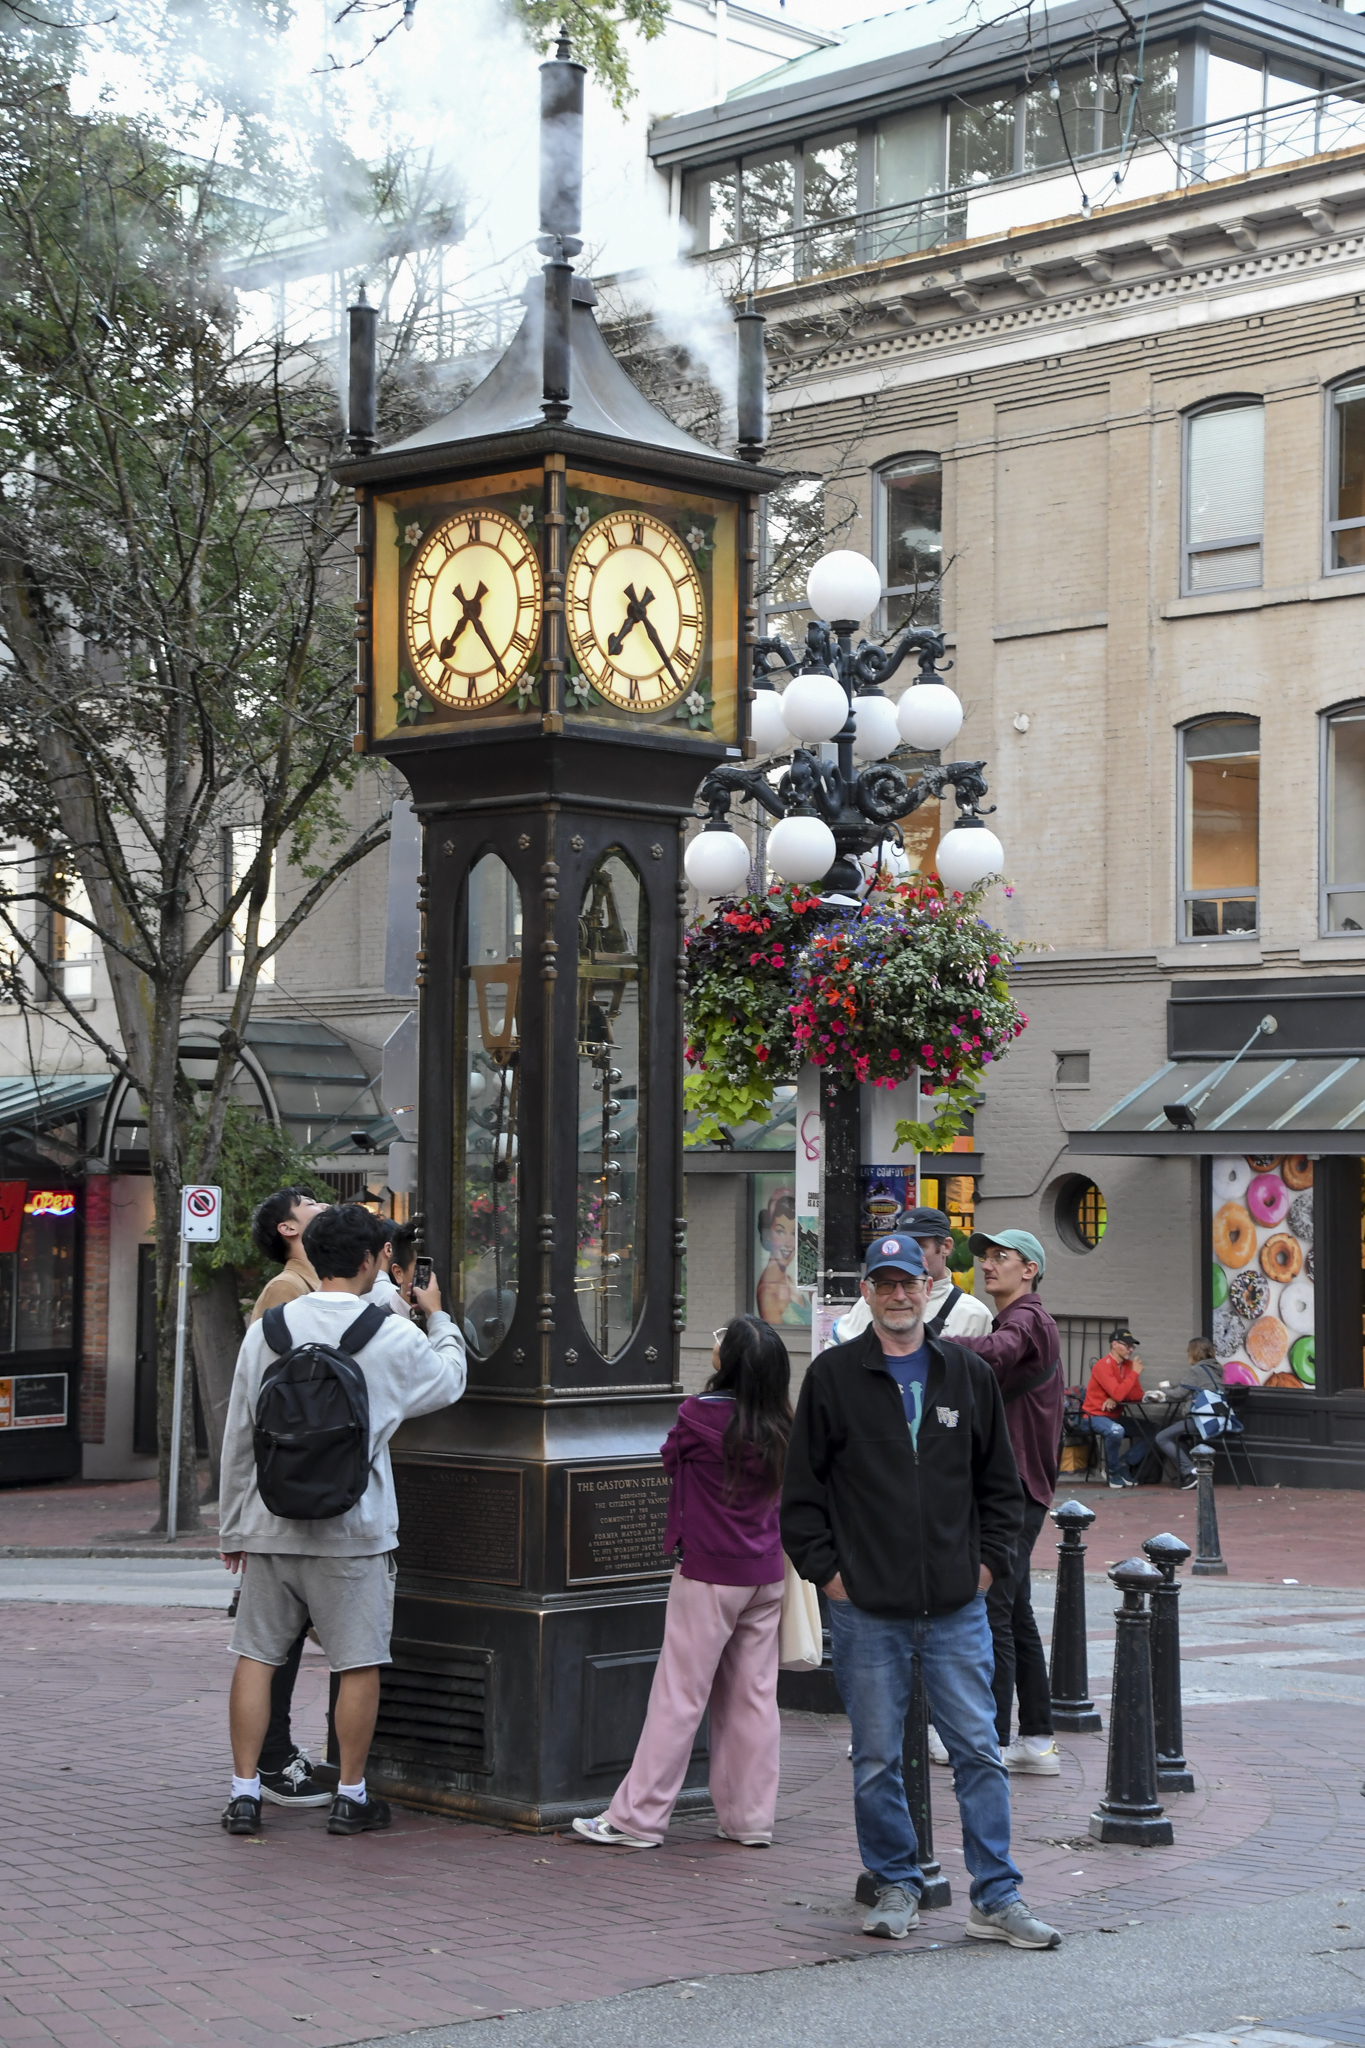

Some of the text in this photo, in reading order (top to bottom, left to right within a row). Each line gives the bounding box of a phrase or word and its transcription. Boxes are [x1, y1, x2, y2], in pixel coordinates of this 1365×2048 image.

[660, 542, 669, 557] I
[581, 556, 596, 575] X
[418, 567, 436, 586] X
[676, 575, 690, 588] II
[520, 596, 534, 608] III
[574, 596, 590, 611] IX
[412, 609, 428, 624] IX
[682, 614, 698, 628] III
[876, 1167, 904, 1178] COMEDY
[577, 1482, 594, 1492] THE
[596, 1479, 639, 1490] GASTOWN
[642, 1477, 668, 1488] STEAM
[600, 1515, 634, 1524] COMMUNITY
[594, 1532, 618, 1540] FORMER
